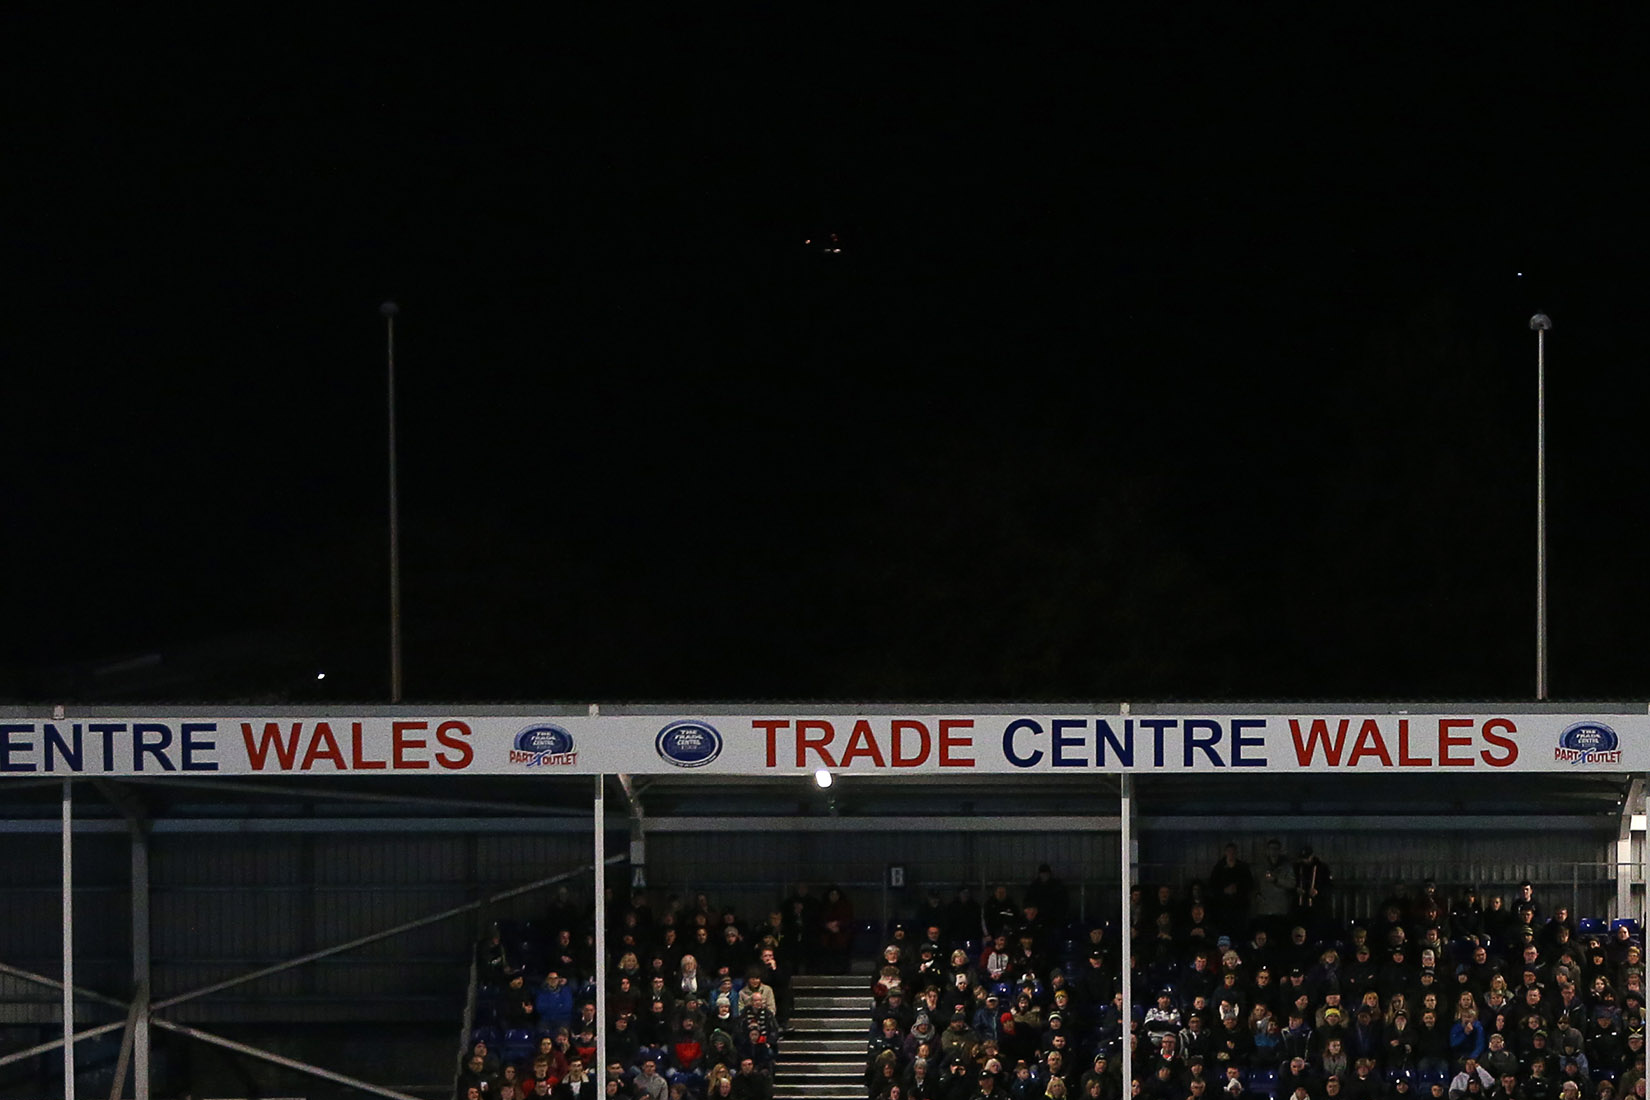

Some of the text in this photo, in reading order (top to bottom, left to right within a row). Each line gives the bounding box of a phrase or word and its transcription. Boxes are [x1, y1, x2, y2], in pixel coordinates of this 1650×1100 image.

[241, 721, 474, 771] WALES
[751, 719, 1519, 768] TRADE CENTRE WALES
